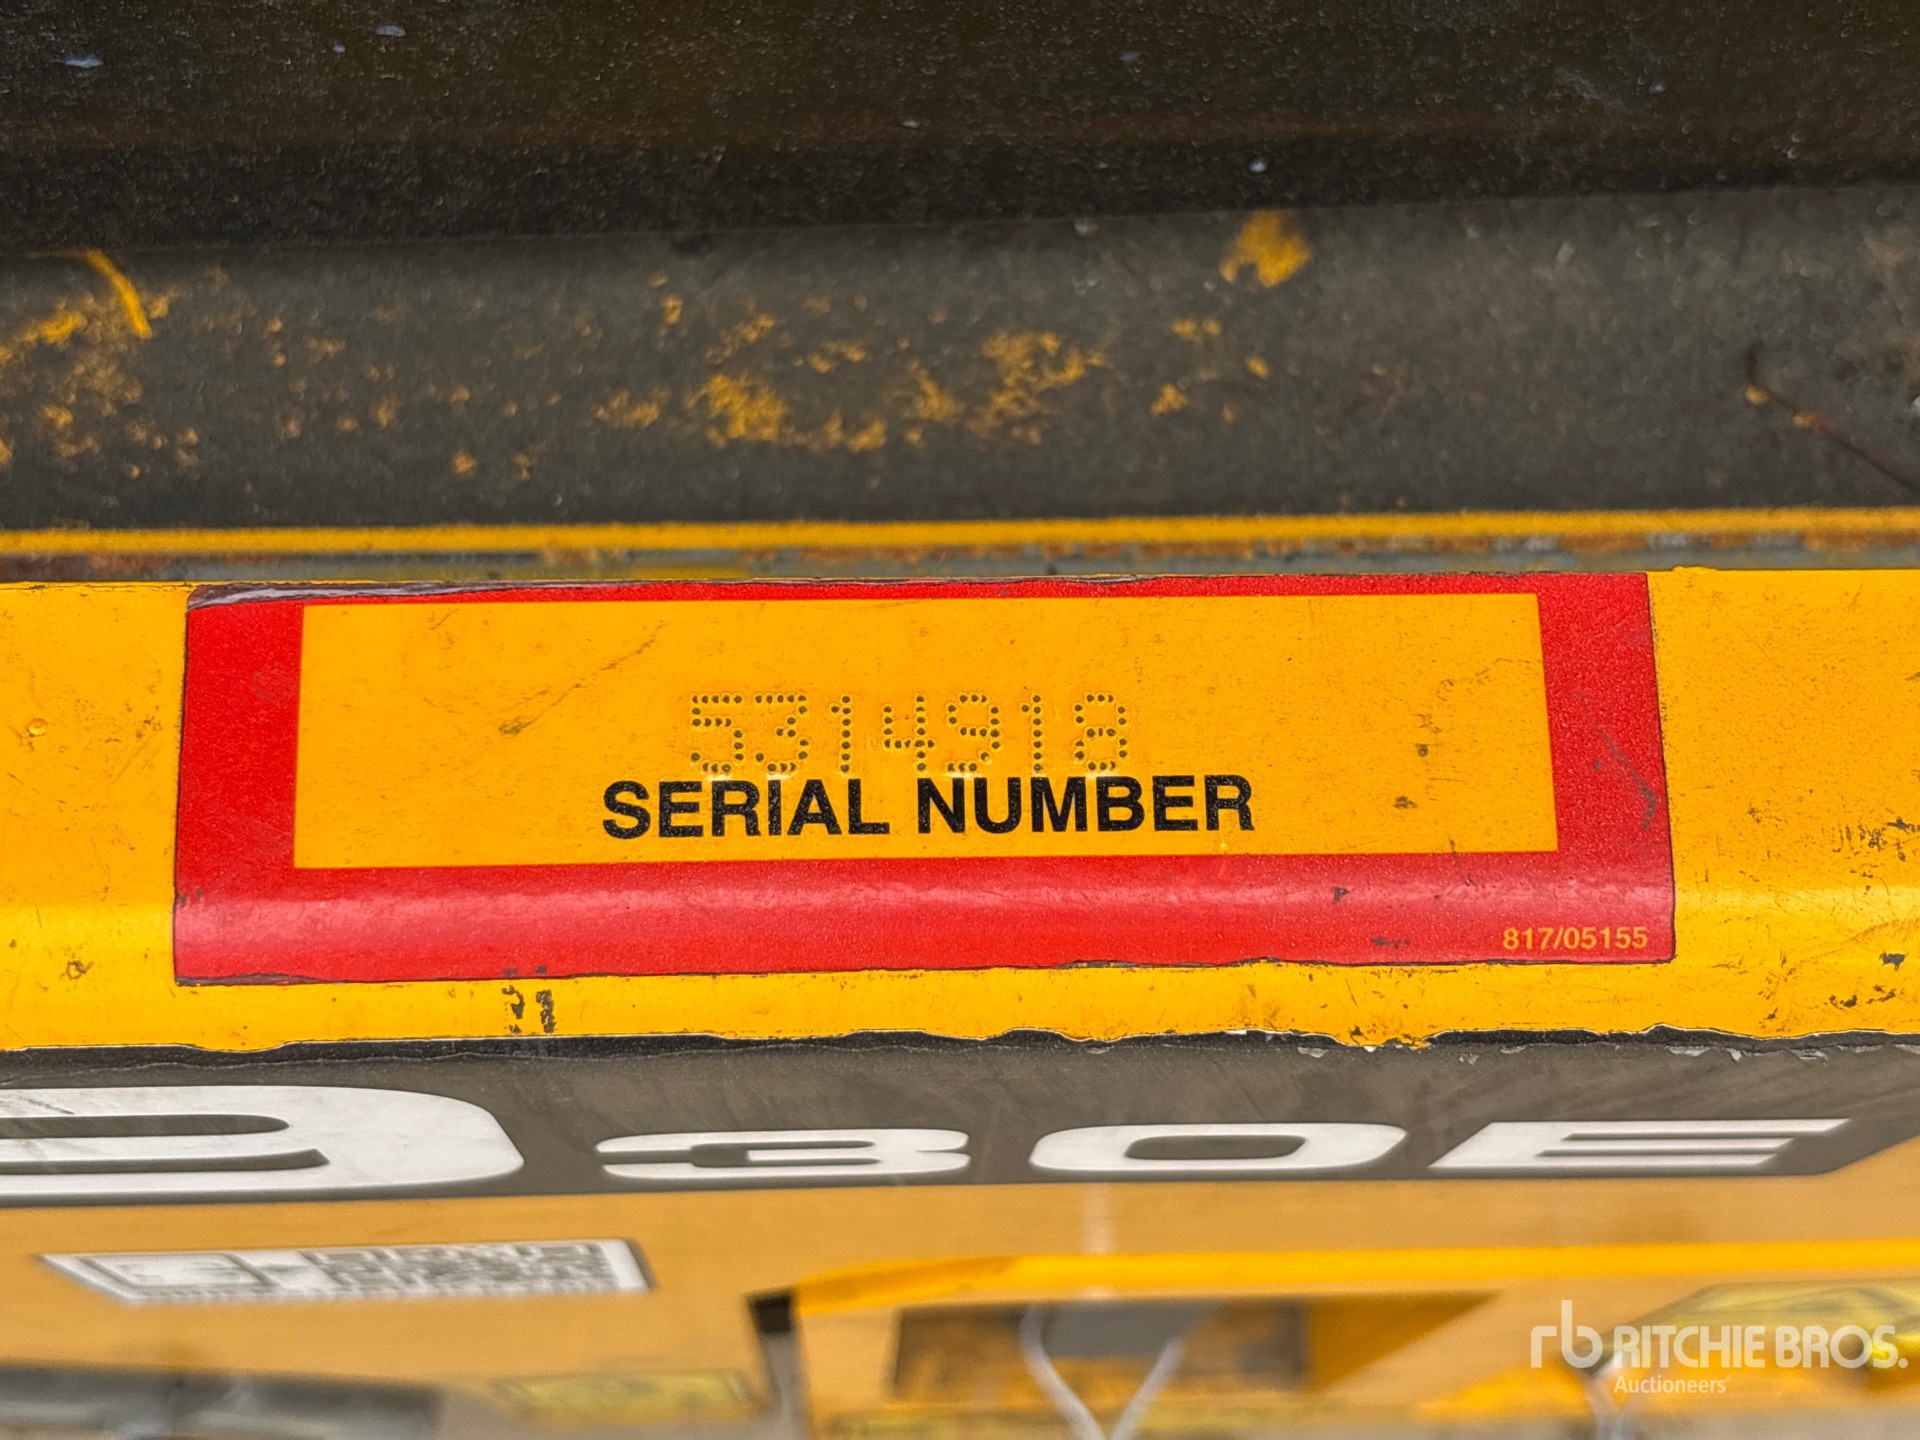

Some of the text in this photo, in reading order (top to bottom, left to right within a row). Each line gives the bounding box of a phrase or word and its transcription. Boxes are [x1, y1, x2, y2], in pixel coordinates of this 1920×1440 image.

[690, 694, 1128, 773] 5314918
[602, 774, 1255, 839] SERIAL NUMBER
[1502, 926, 1649, 951] 817/05155
